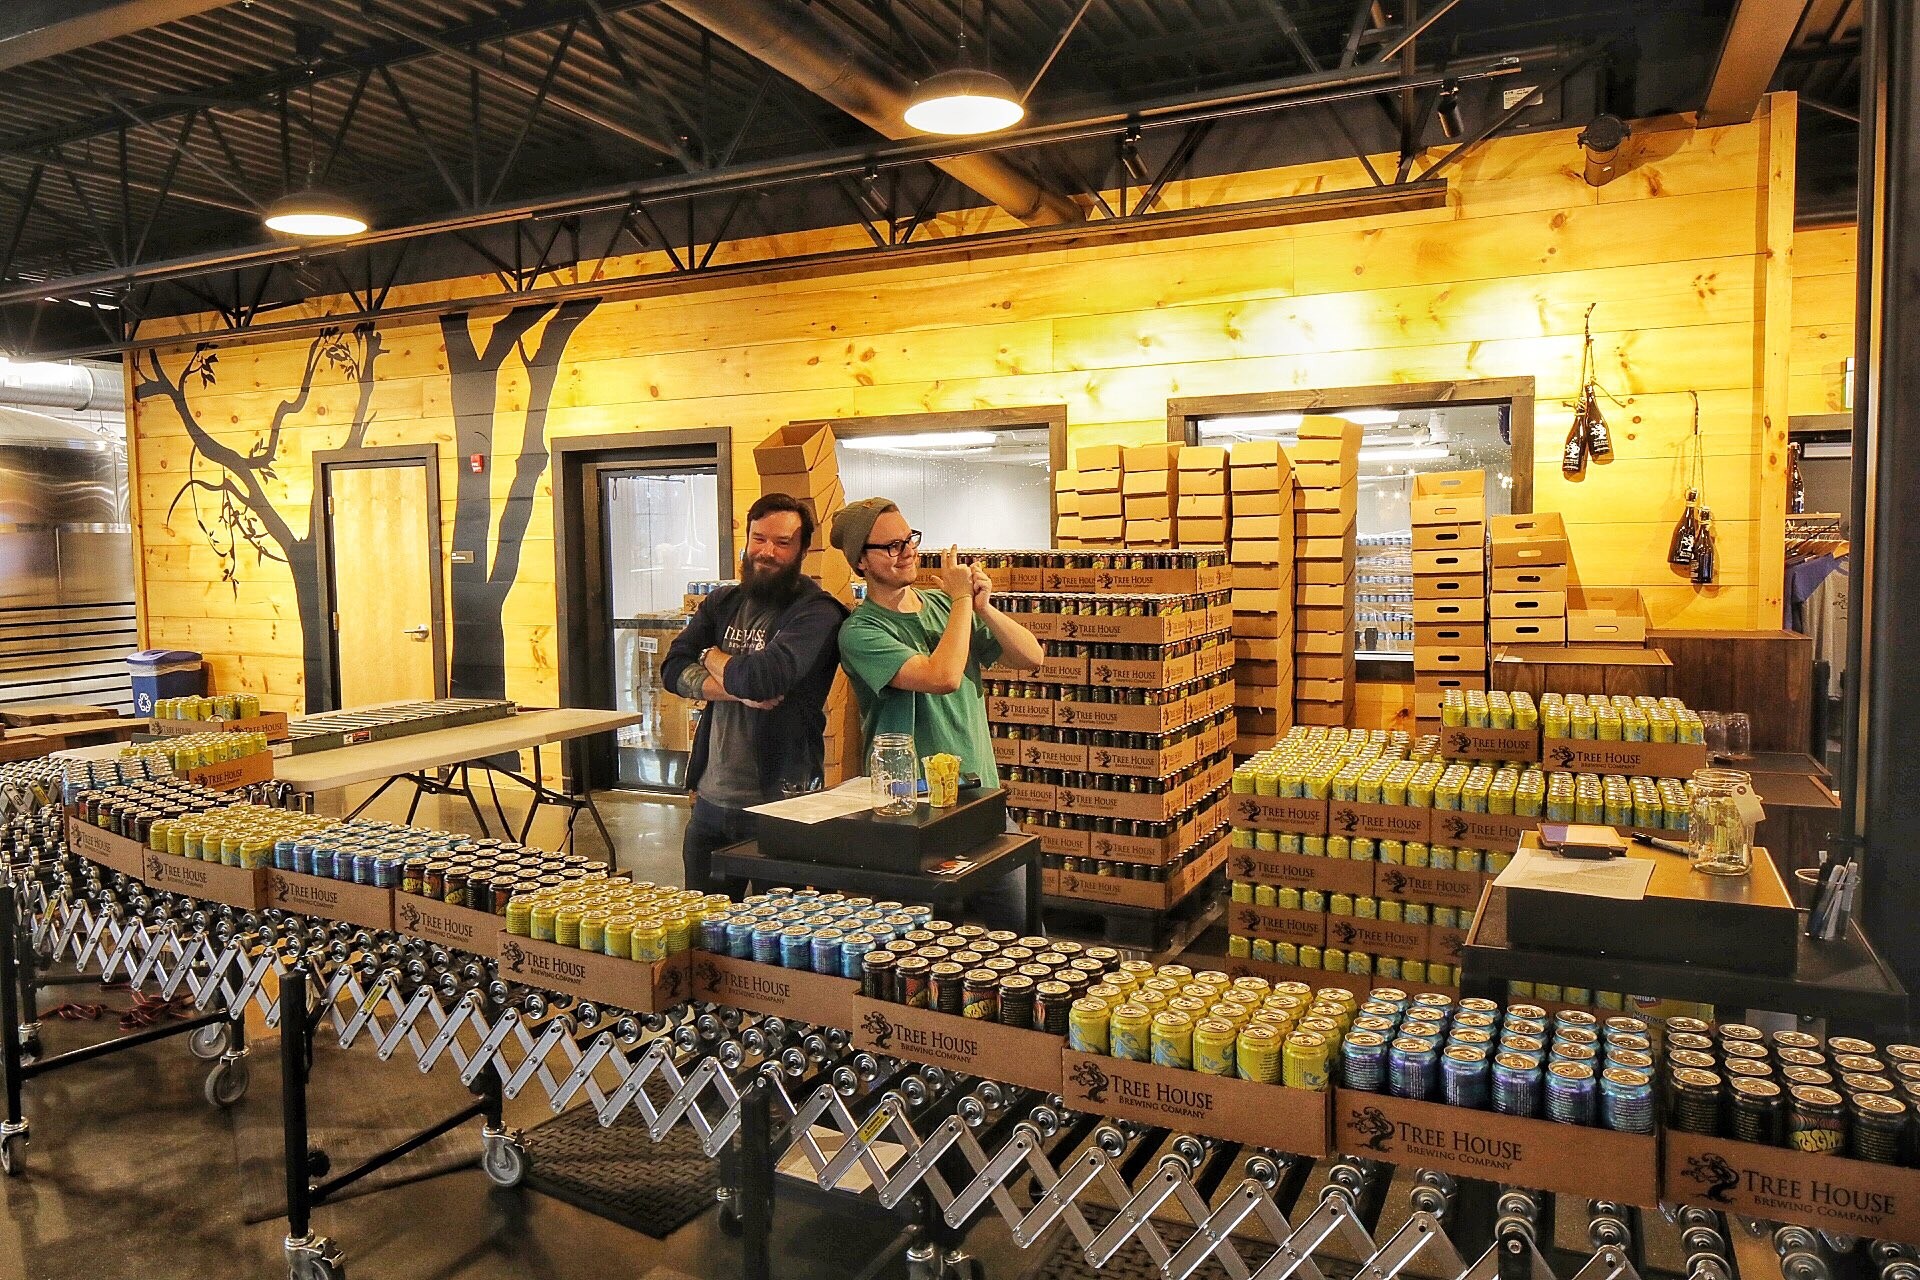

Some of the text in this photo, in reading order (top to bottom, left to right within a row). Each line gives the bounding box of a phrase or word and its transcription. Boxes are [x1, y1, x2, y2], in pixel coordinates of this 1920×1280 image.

[1029, 622, 1052, 630] HOUSE
[1079, 624, 1095, 633] TREE
[1041, 665, 1081, 675] TREE HOUSE
[1112, 669, 1156, 679] TREE HOUSE
[1010, 704, 1050, 715] TREE HOUSE
[1076, 711, 1117, 721] TREE HOUSE
[1472, 738, 1530, 749] TREE HOUSE
[1042, 752, 1081, 762] TREE HOUSE
[1112, 755, 1154, 765] TREE HOUSE
[1576, 751, 1641, 763] TREE HOUSE
[1012, 788, 1051, 798] TREE HOUSE
[1076, 795, 1117, 806] TREE HOUSE
[1262, 806, 1320, 821] TREE HOUSE
[1360, 815, 1422, 830] TREE HOUSE
[1469, 822, 1495, 835] TREE
[1113, 844, 1155, 855] TREE HOUSE
[163, 863, 207, 883] TREE HOUSE
[1257, 861, 1315, 878] TREE HOUSE
[289, 883, 338, 903] TREE HOUSE
[1408, 877, 1471, 894] TREE HOUSE
[421, 912, 473, 938] TREE HOUSE
[1261, 916, 1318, 932] TREE HOUSE
[525, 951, 586, 979] TREE HOUSE
[531, 968, 581, 986] BREWING COMPANY
[722, 970, 790, 998] TREE HOUSE
[894, 1024, 978, 1056] TREE HOUSE
[901, 1043, 972, 1063] BREWING COMPANY
[1110, 1074, 1213, 1110] TREE HOUSE
[1119, 1096, 1206, 1119] BREWING COMPANY
[1396, 1121, 1522, 1161] TREE HOUSE
[1407, 1144, 1512, 1170] BREWING COMPANY
[1742, 1170, 1896, 1215] TREE HOUSE
[1754, 1196, 1883, 1226] BREWING COMPANY
